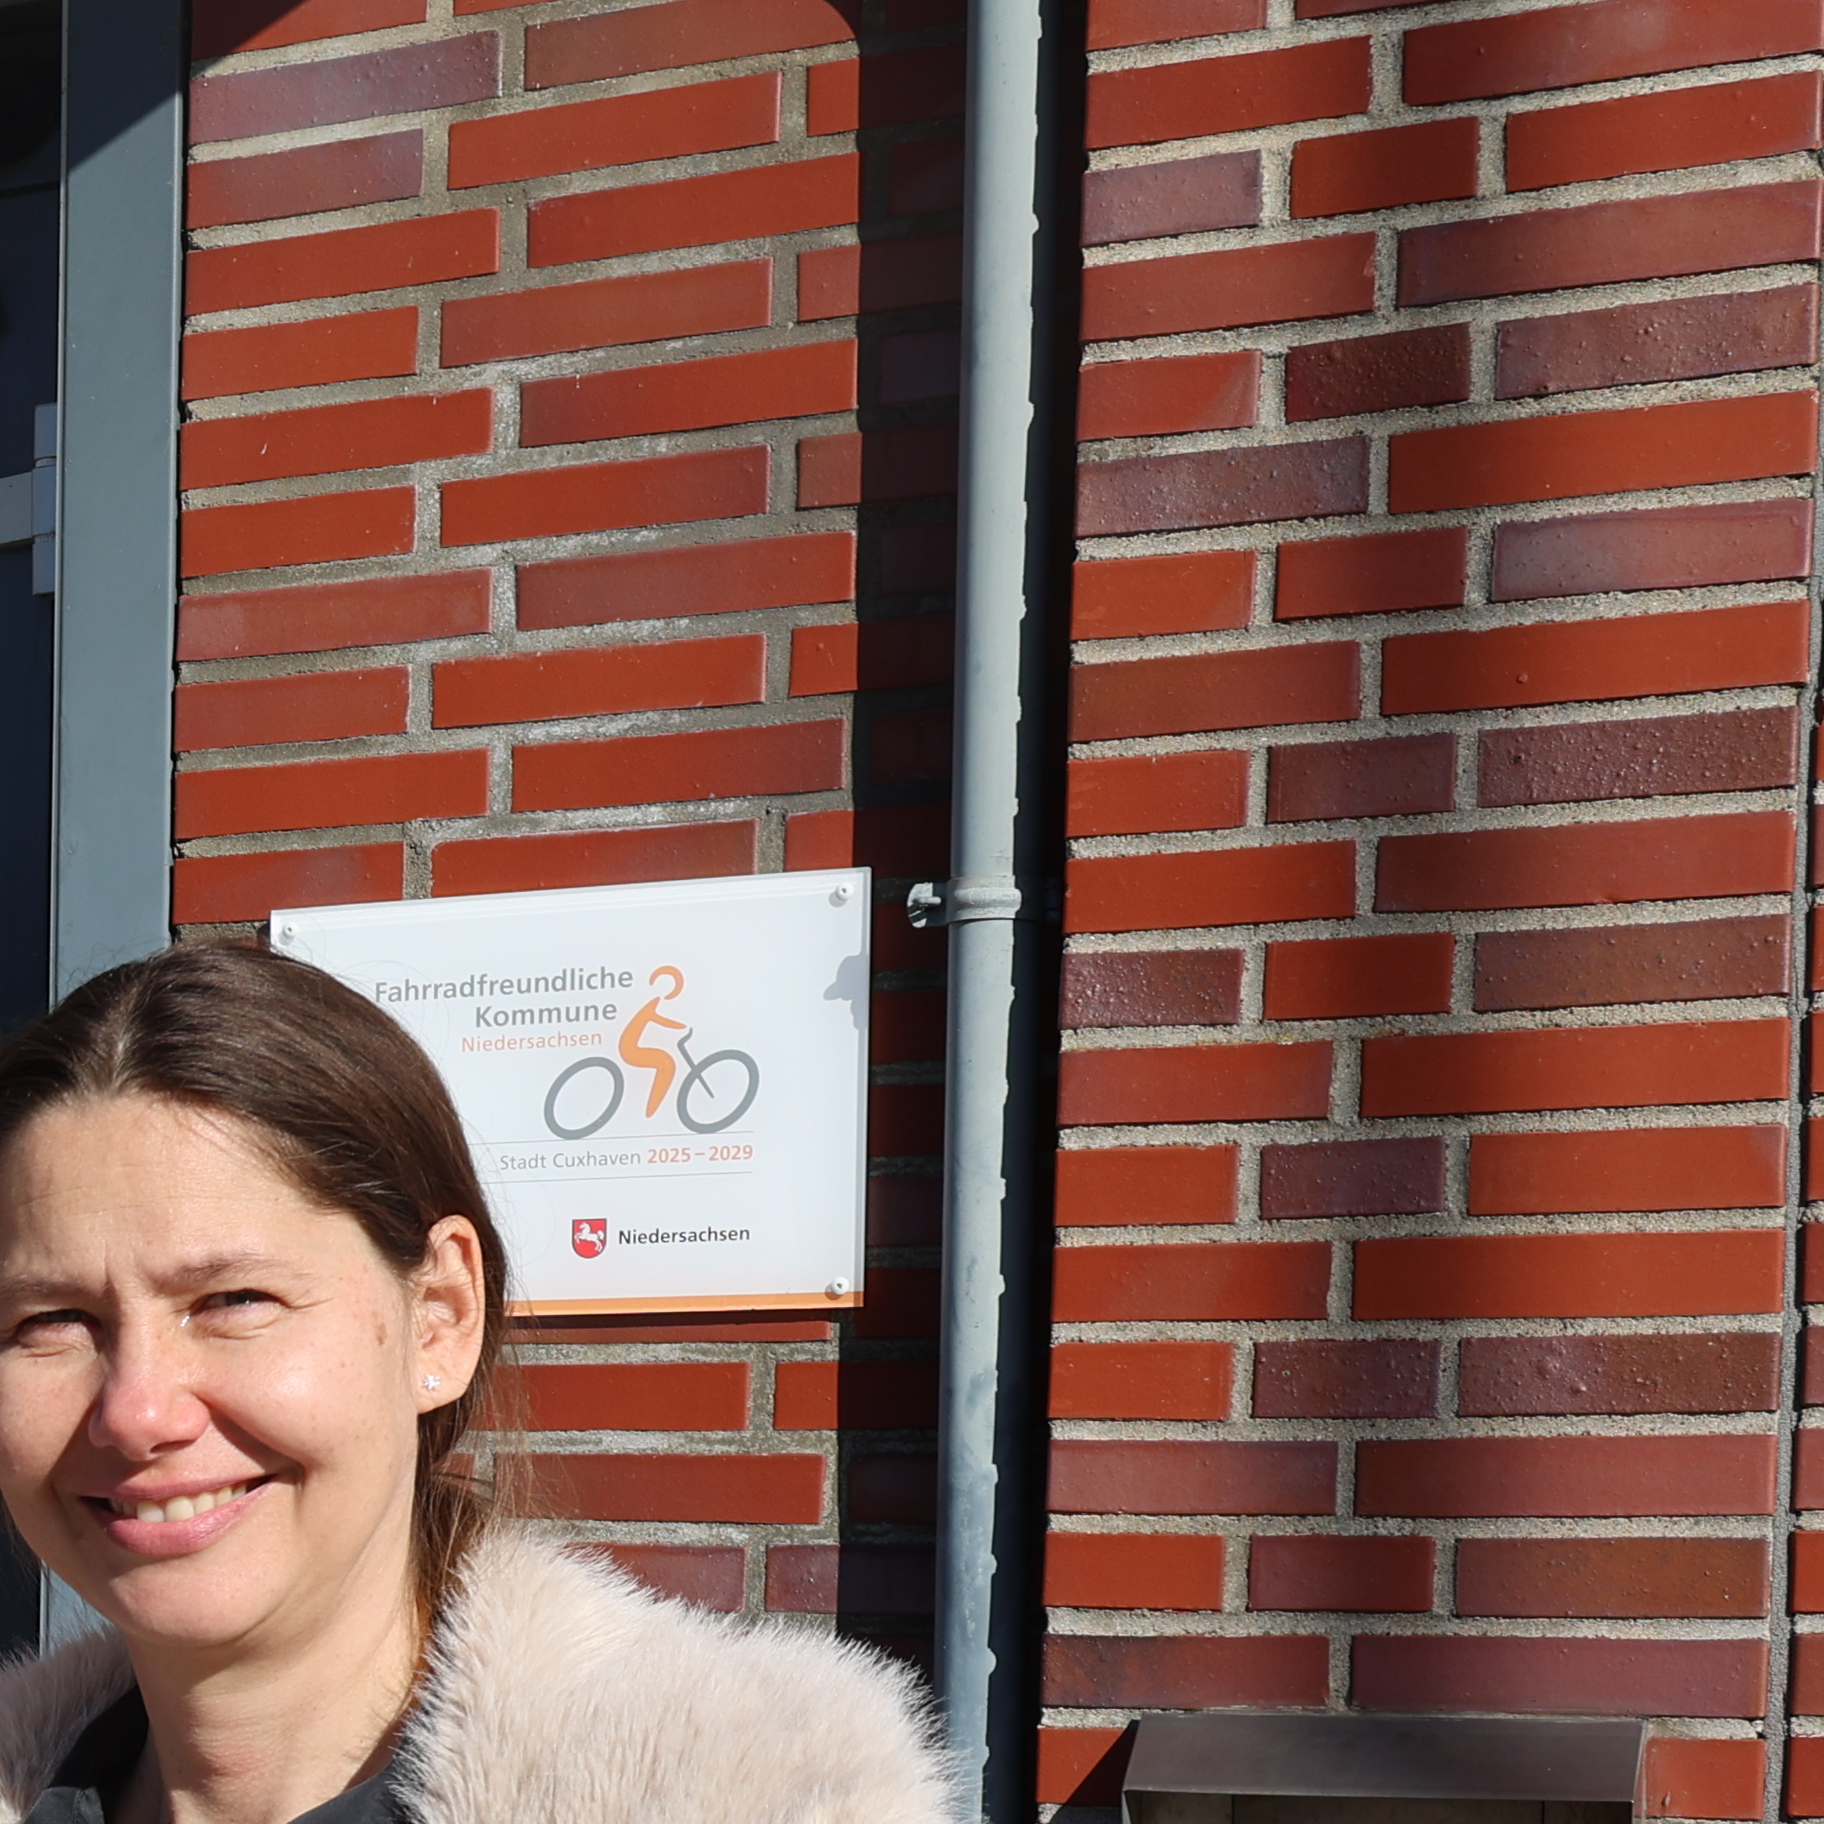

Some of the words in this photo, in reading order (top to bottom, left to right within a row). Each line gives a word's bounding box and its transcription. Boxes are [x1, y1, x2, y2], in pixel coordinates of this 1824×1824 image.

[374, 965, 634, 1004] Fahrradfreundliche
[474, 1000, 618, 1028] Kommune
[461, 1029, 603, 1053] Niedersachsen
[499, 1150, 547, 1171] Stadt
[552, 1149, 642, 1169] Cuxhaven
[618, 1226, 751, 1246] Niedersachsen
